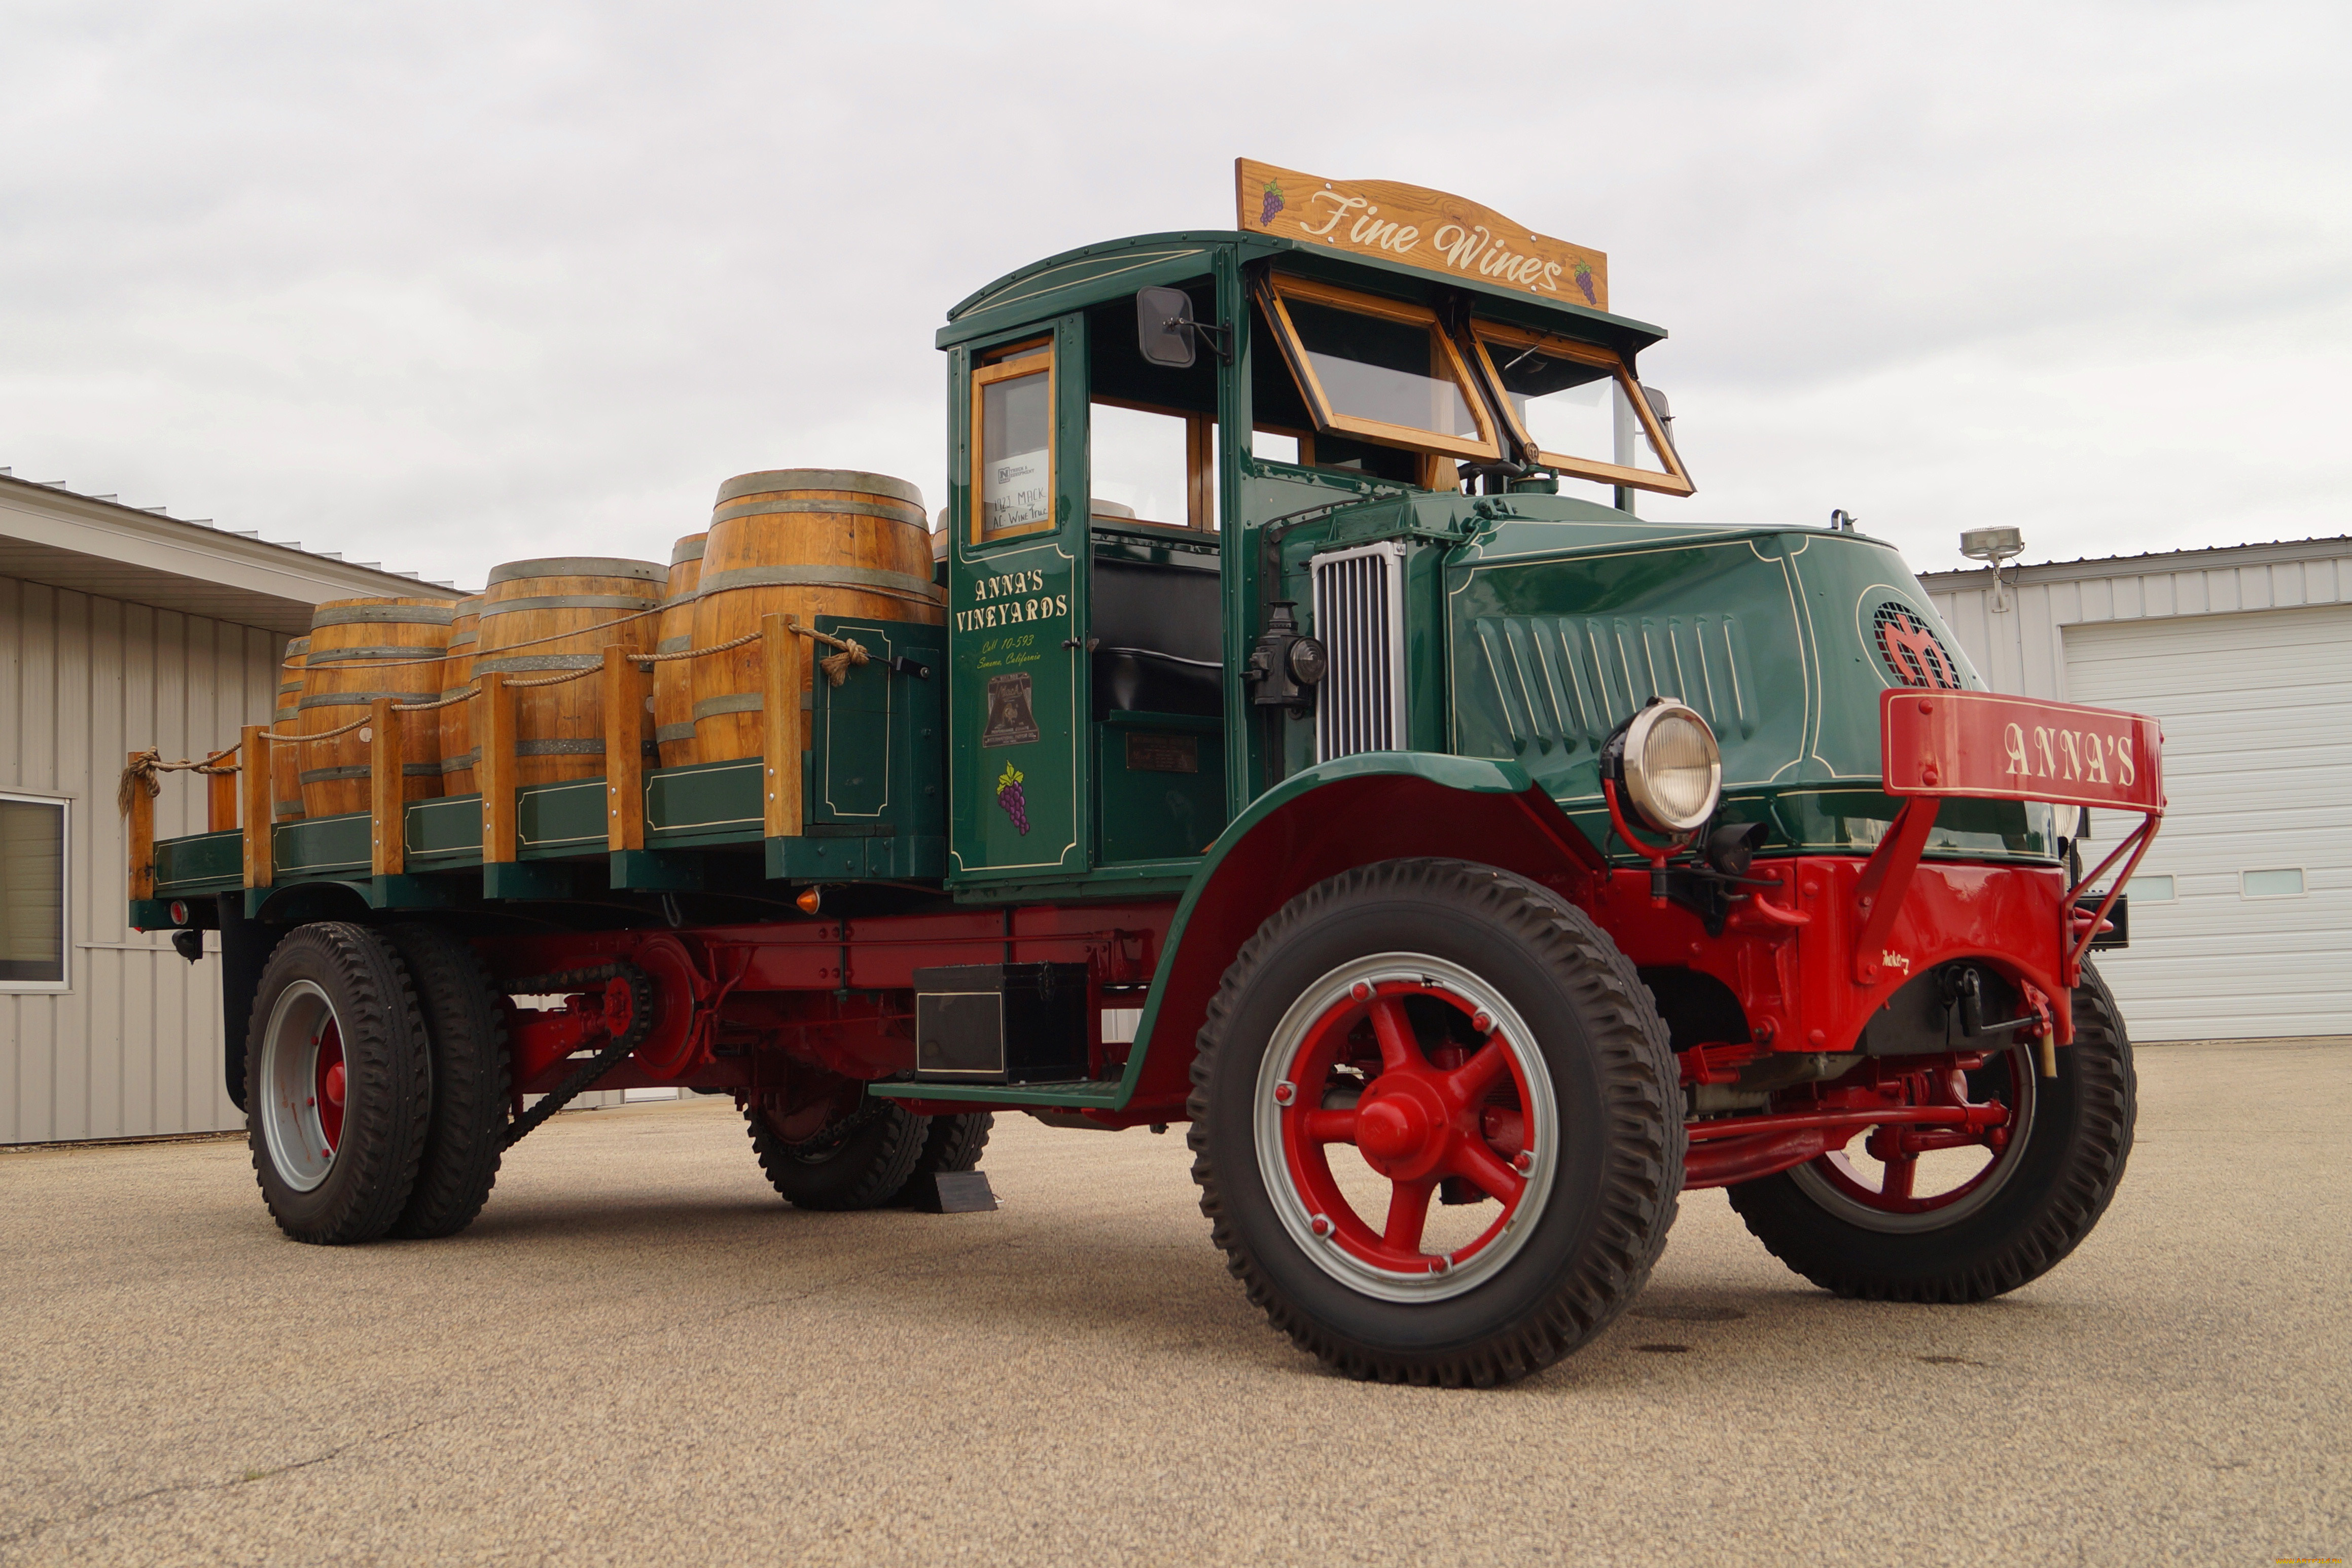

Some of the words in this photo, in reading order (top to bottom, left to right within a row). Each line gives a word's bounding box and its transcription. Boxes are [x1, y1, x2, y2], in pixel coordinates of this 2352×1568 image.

[1300, 191, 1420, 253] Fine
[1434, 225, 1562, 292] Wines
[994, 495, 1011, 512] 1923
[1018, 487, 1046, 505] MACK
[1029, 504, 1048, 519] Truc
[975, 569, 1043, 601] ANNA'S
[956, 594, 1067, 633] VINEYARDS
[982, 638, 998, 654] Call
[1001, 634, 1034, 650] 10-593
[1006, 652, 1041, 666] California
[2004, 722, 2135, 787] ANNA'S
